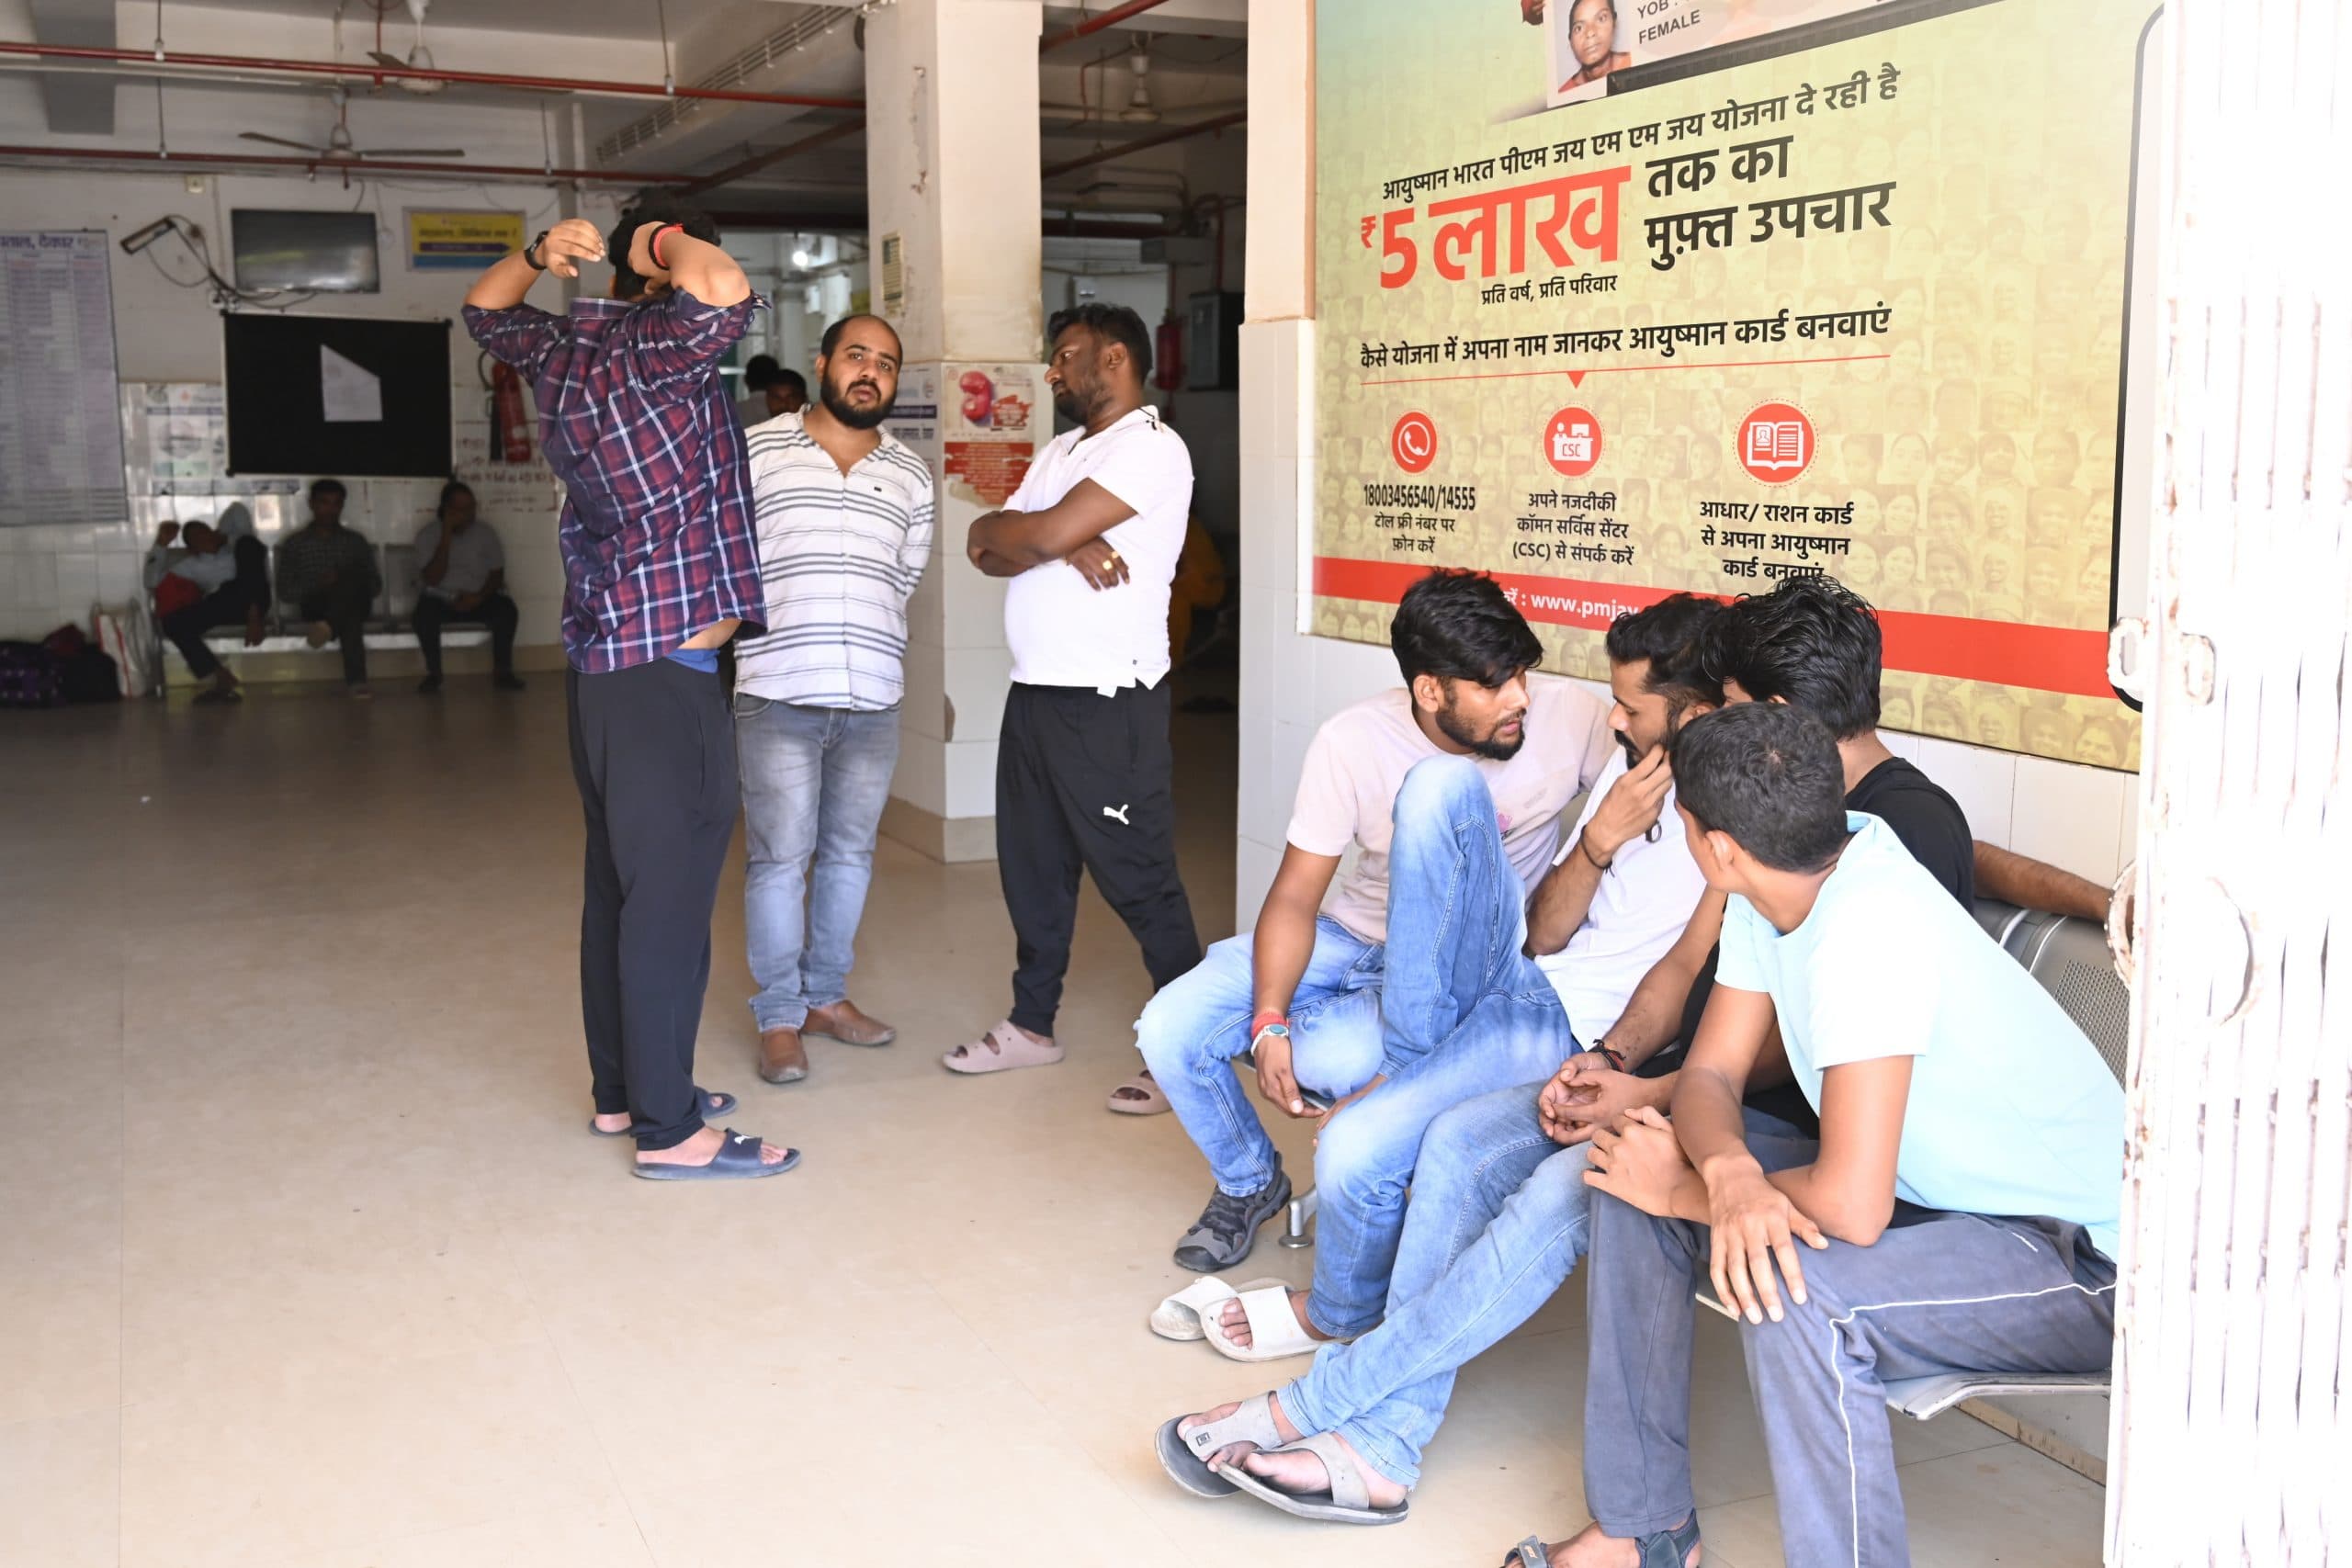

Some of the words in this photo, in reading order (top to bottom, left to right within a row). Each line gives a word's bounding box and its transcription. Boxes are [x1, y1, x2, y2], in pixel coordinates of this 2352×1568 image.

[1638, 9, 1702, 44] FEMALE
[1382, 168, 1450, 203] आयुष्मान
[1453, 158, 1495, 184] भारत
[1499, 146, 1548, 175] पीएम
[1552, 138, 1587, 164] जय
[1590, 130, 1623, 155] एम
[1627, 121, 1661, 149] एम
[1667, 113, 1705, 140] जय
[1711, 96, 1789, 132] योजना
[1795, 83, 1817, 116] दे
[1823, 70, 1871, 110] रही
[1877, 62, 1901, 100] है
[1645, 149, 1720, 197] तक
[1729, 134, 1794, 184] का
[1428, 165, 1632, 281] लाख
[1748, 181, 1897, 243] उपचार
[1481, 284, 1506, 305] प्रति
[1510, 279, 1535, 305] वर्ष,
[1539, 276, 1566, 299] प्रति
[1570, 273, 1618, 295] परिवार
[1361, 343, 1388, 368] कैसे
[1392, 340, 1439, 365] योजना
[1444, 336, 1459, 362] में
[1463, 338, 1510, 360] अपना
[1514, 334, 1548, 356] नाम
[1553, 329, 1623, 355] जानकर
[1629, 321, 1728, 357] आयुष्मान
[1734, 308, 1789, 344] कार्ड
[1795, 300, 1892, 340] बनवाएं
[1562, 444, 1581, 457] CSC
[1363, 484, 1476, 512] 18003456540/14555
[1528, 490, 1558, 508] अपने
[1561, 491, 1616, 512] नजदीकी
[1374, 512, 1394, 528] टोल
[1396, 512, 1412, 529] फ्री
[1415, 513, 1438, 531] नंबर
[1441, 518, 1455, 532] पर
[1517, 513, 1553, 533] कॉमन
[1556, 513, 1596, 536] सर्विस
[1599, 518, 1629, 538] सेंटर
[1700, 502, 1758, 523] आधार/
[1763, 504, 1809, 523] राशन
[1814, 502, 1854, 525] कार्ड
[1417, 536, 1435, 553] करें
[1513, 541, 1551, 562] (CSC)
[1555, 540, 1567, 558] से
[1570, 543, 1607, 562] संपर्क
[1611, 546, 1634, 566] करें
[1701, 525, 1716, 546] से
[1721, 531, 1766, 549] अपना
[1771, 534, 1850, 559] आयुष्मान
[1722, 557, 1758, 578] कार्ड
